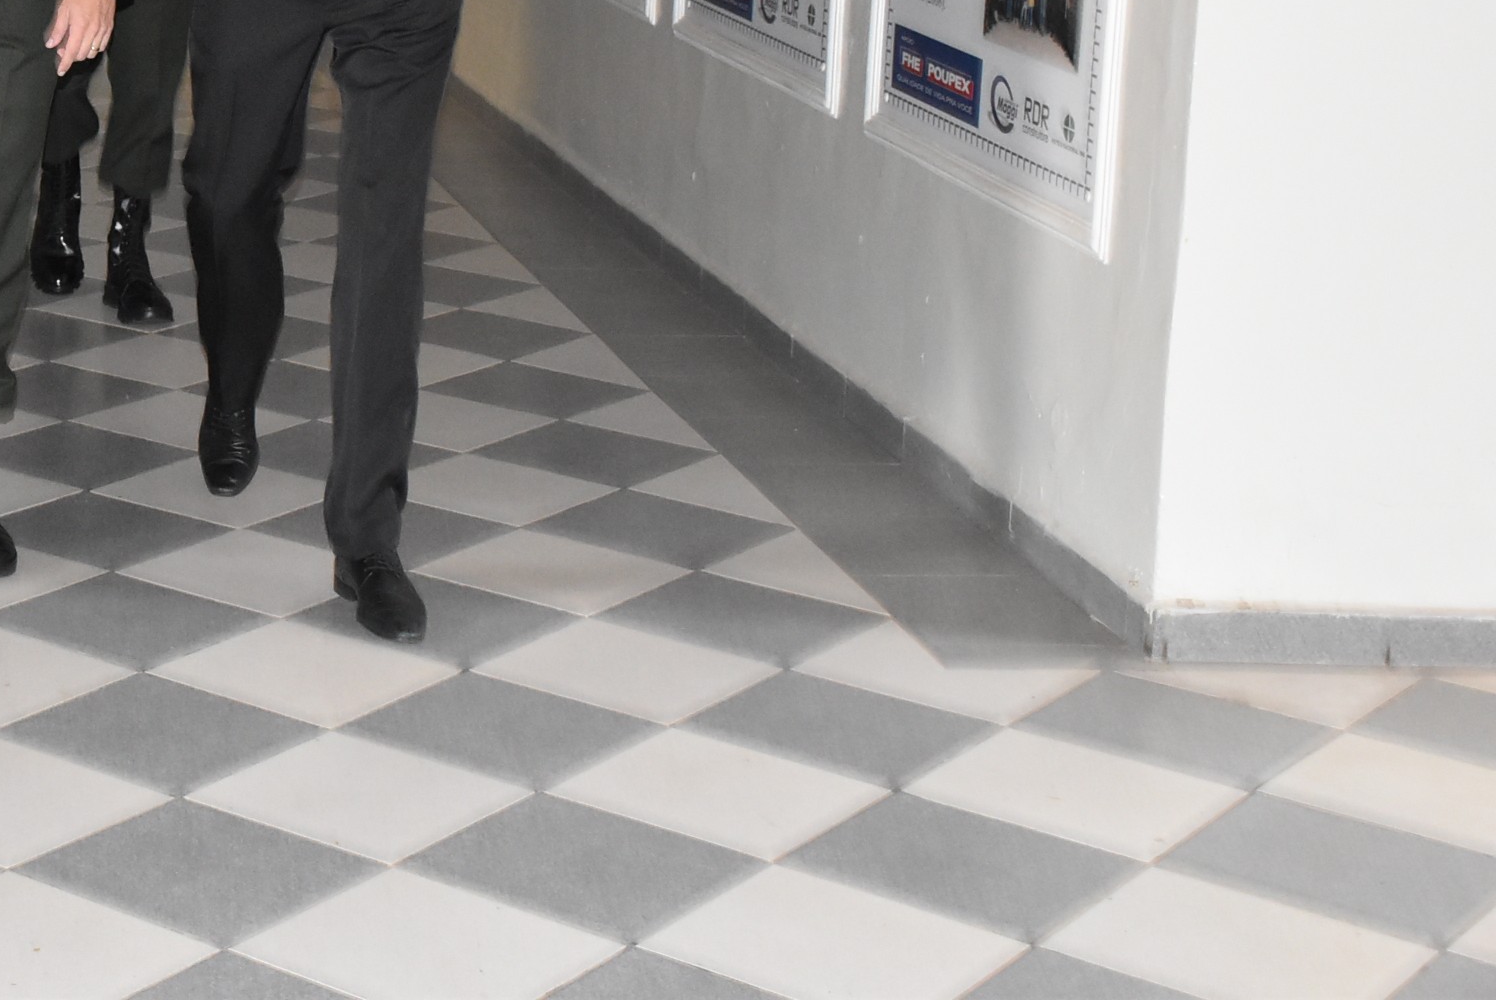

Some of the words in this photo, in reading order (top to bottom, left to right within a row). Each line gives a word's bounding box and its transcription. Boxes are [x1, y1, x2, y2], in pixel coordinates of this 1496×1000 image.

[901, 51, 922, 73] FHE
[927, 62, 972, 96] POUPEX
[1023, 96, 1050, 131] RDR
